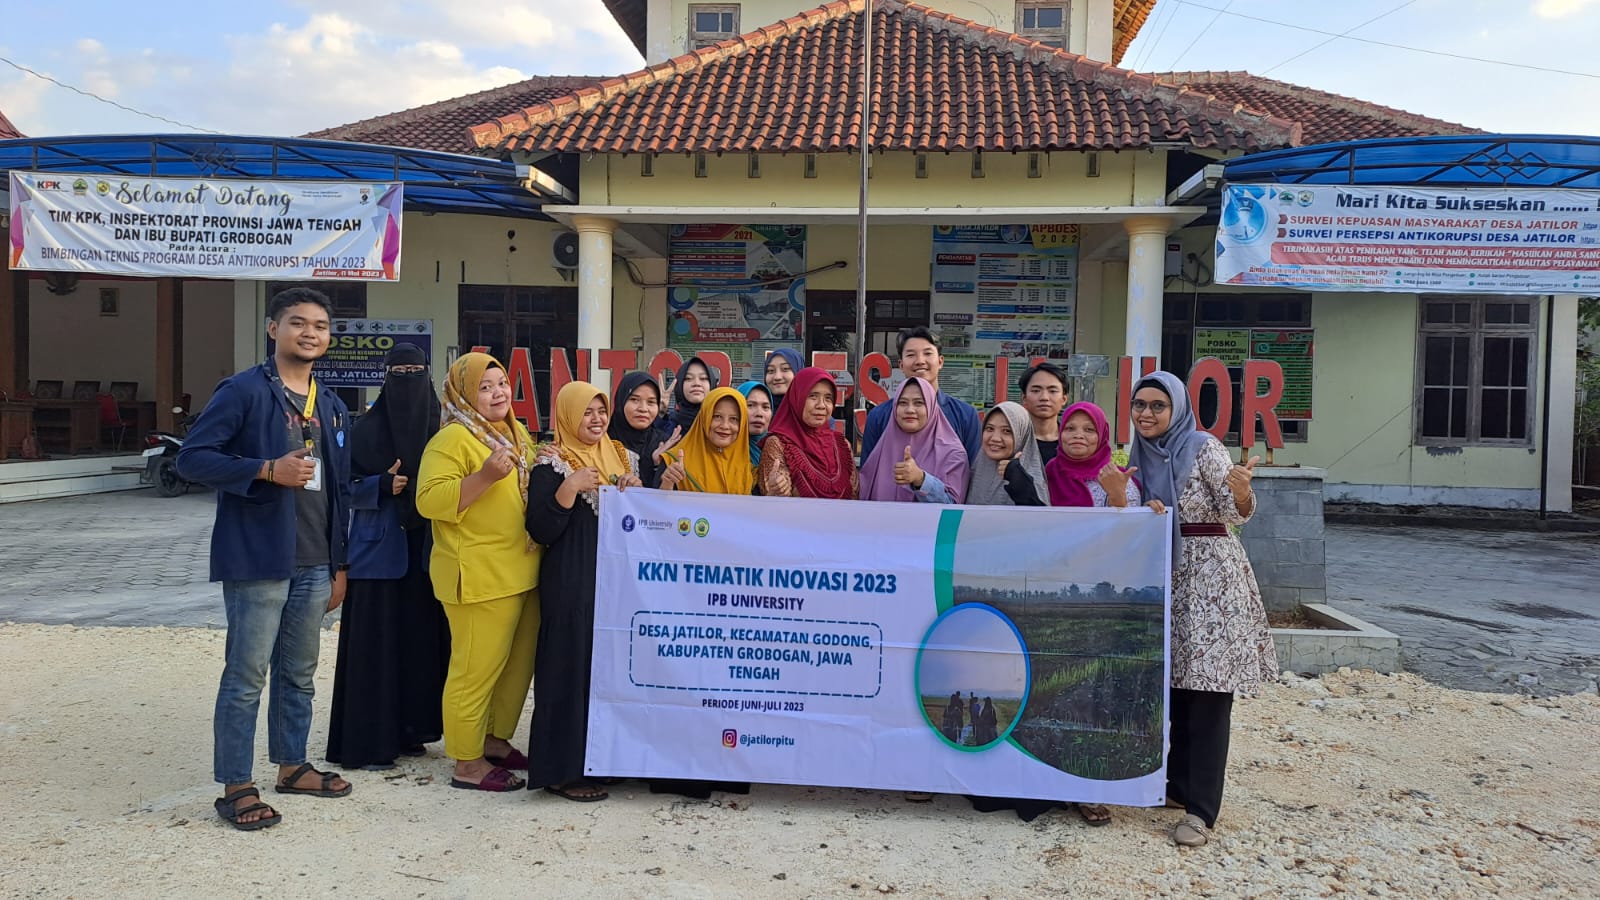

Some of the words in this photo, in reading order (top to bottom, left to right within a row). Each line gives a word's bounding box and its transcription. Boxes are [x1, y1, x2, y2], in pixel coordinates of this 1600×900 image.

[37, 181, 61, 190] KPK
[115, 181, 208, 204] Selamat
[215, 185, 292, 215] Datang
[1336, 194, 1381, 209] Mari
[1386, 194, 1430, 210] Kita
[1435, 194, 1546, 212] Sukseskan
[49, 209, 72, 223] TIM
[76, 211, 107, 227] KPK,
[109, 213, 200, 228] INSPEKTORAT
[202, 215, 264, 230] PROVINSI
[266, 216, 303, 231] JAWA
[307, 218, 362, 232] TENGAH
[1290, 216, 1333, 226] SURVEI
[1336, 216, 1402, 228] KEPUASAN
[1404, 218, 1487, 229] MASYARAKAT
[1490, 219, 1524, 230] DESA
[1526, 220, 1579, 230] JATILOR
[115, 228, 141, 242] DAN
[145, 228, 168, 242] IBU
[170, 230, 215, 244] BUPATI
[218, 231, 293, 246] GROBOGAN
[734, 230, 752, 240] 2021
[1289, 229, 1332, 239] SURVEI
[1336, 229, 1394, 240] PERSEPSI
[1398, 230, 1484, 242] ANTIKORUPSI
[1486, 232, 1520, 243] DESA
[1522, 233, 1576, 244] JATILOR
[168, 244, 196, 253] Pada
[199, 245, 230, 254] Acara
[1335, 246, 1354, 254] ATAS
[1356, 246, 1396, 255] PENILAIAN
[1398, 248, 1419, 256] YANG
[1446, 249, 1469, 257] ANDA
[1554, 250, 1578, 258] ANDA
[41, 246, 102, 262] BIMBINGAN
[104, 250, 140, 264] TEKNIS
[142, 251, 196, 265] PROGRAM
[198, 253, 226, 266] DESA
[228, 254, 300, 268] ANTIKORUPSI
[302, 256, 340, 269] TAHUN
[342, 256, 366, 269] 2023
[1326, 254, 1347, 262] AGAR
[1426, 257, 1444, 265] DAN
[1446, 258, 1511, 266] MENINGKATKAN
[1513, 259, 1551, 267] KUALITAS
[1553, 260, 1600, 268] PELAYANAN
[328, 336, 394, 350] OSKO
[342, 371, 385, 379] JATILOR
[638, 562, 678, 582] KKN
[683, 564, 764, 587] TEMATIK
[769, 568, 848, 591] INOVASI
[853, 572, 898, 594] 2023
[707, 593, 728, 607] IPB
[731, 594, 804, 611] UNIVERSITY
[638, 624, 670, 638] DESA
[672, 626, 727, 642] JATILOR,
[730, 628, 810, 645] KECAMATAN
[812, 633, 874, 650] GODONG,
[657, 644, 734, 660] KABUPATEN
[737, 646, 814, 664] GROBOGAN,
[816, 650, 853, 666] JAWA
[728, 666, 780, 681] TENGAH
[702, 698, 740, 710] PERIODE
[740, 700, 782, 712] JUNI-JULI
[784, 701, 804, 712] 2023
[739, 734, 795, 748] @jatilorpitu
